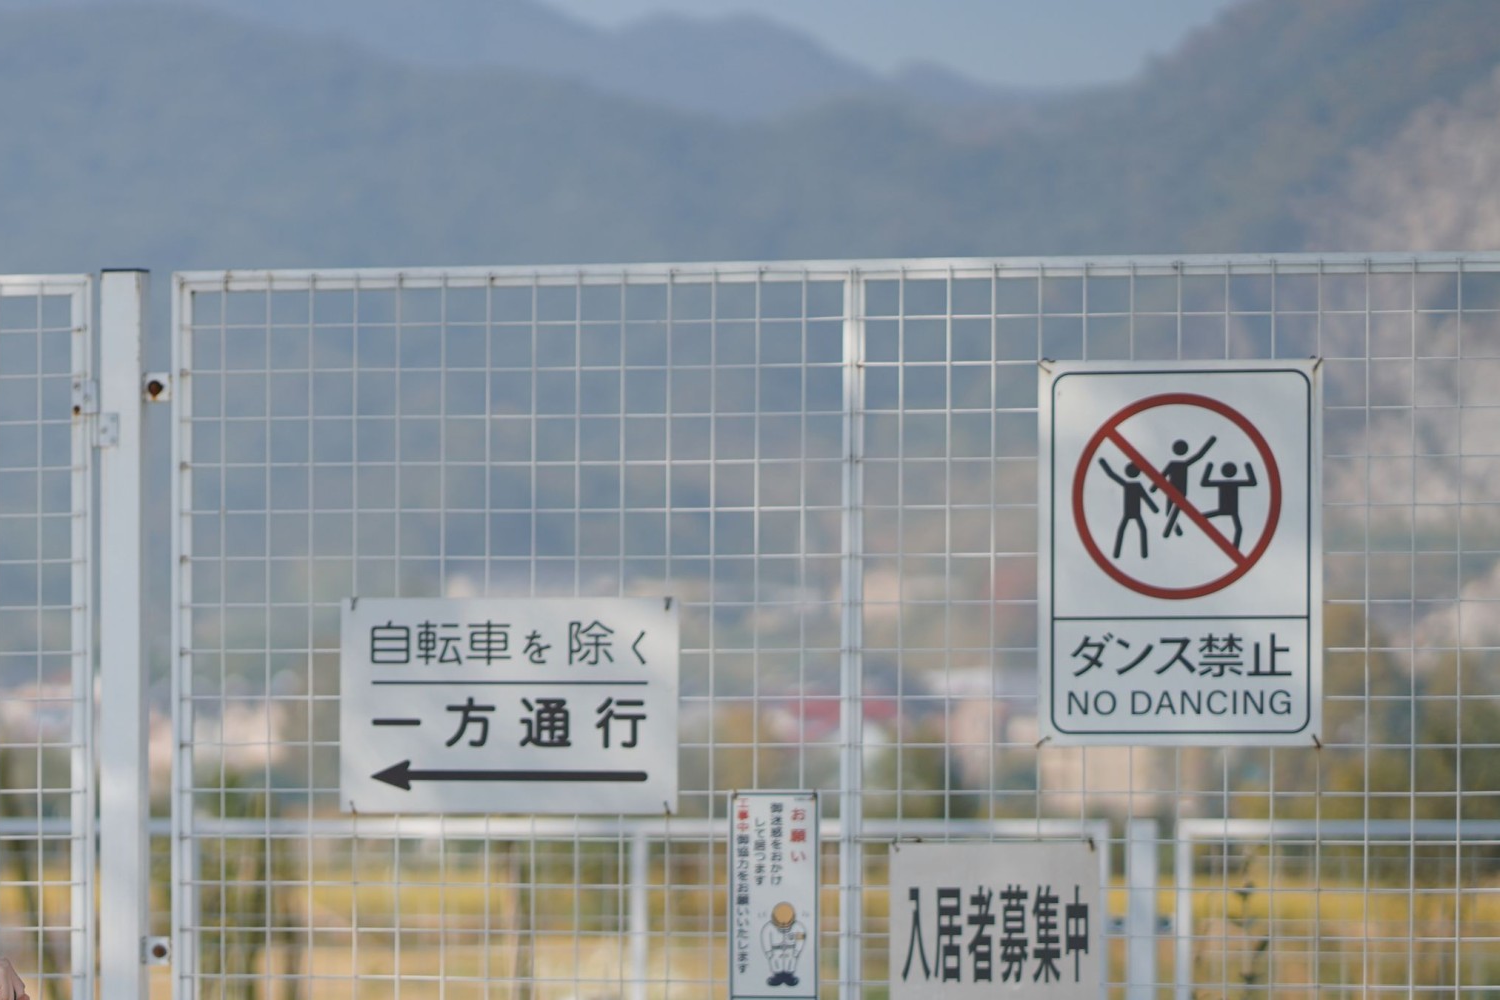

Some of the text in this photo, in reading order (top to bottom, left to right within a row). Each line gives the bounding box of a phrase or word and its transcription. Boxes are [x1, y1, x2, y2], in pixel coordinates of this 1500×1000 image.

[370, 619, 648, 667] 自転車を除く
[1070, 632, 1293, 678] ダンス禁止
[371, 696, 648, 749] 一方通行
[1067, 689, 1293, 716] NO DANCING
[789, 807, 807, 863] お願い
[901, 884, 1090, 984] 入居者募集中
